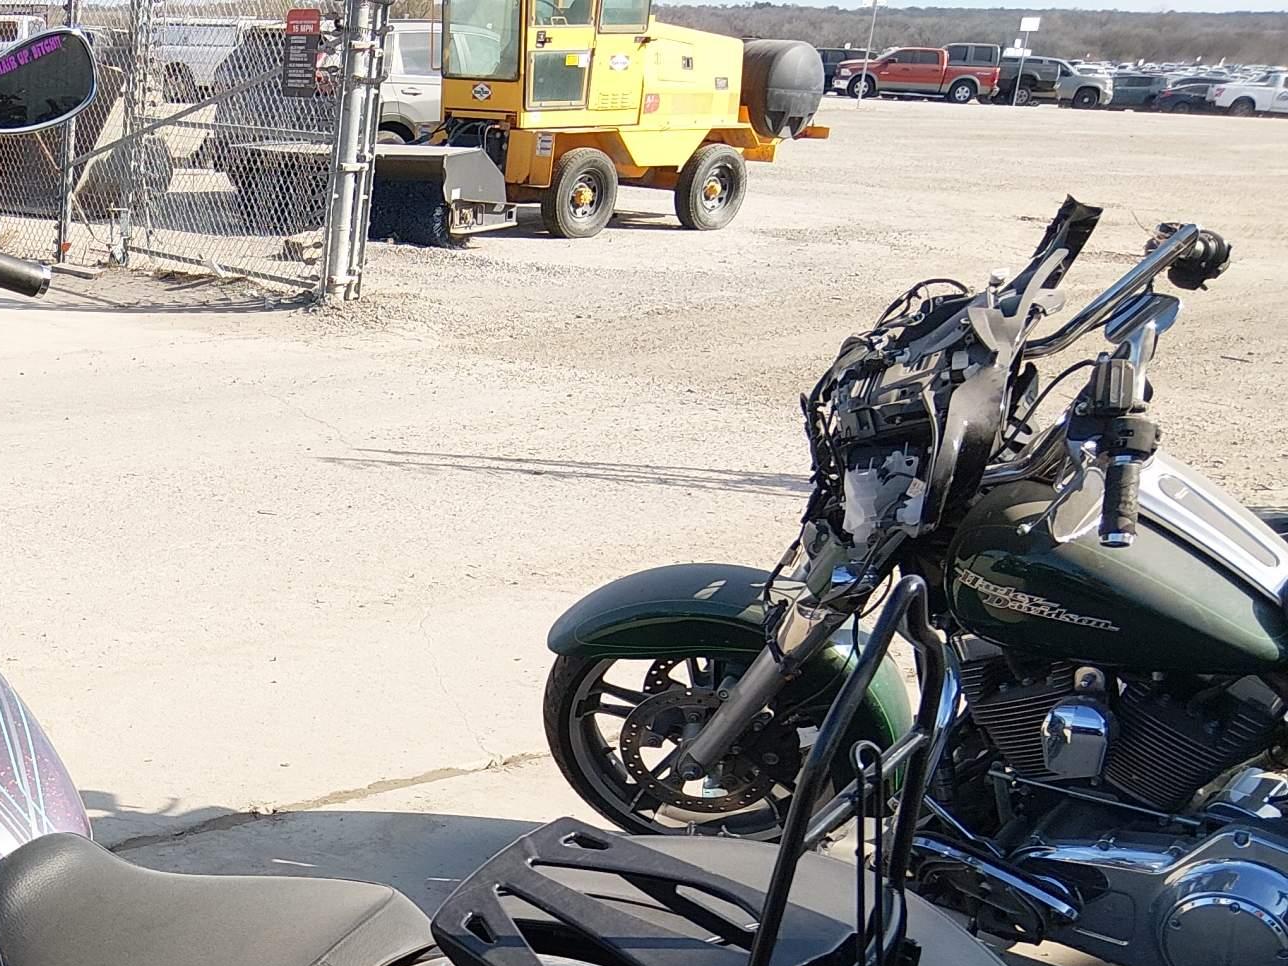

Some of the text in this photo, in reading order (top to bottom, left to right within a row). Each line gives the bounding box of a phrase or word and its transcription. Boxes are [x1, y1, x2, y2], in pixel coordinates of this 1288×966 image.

[292, 24, 314, 33] 15 MPH
[957, 568, 1061, 607] Harley
[982, 593, 1120, 632] Davidson
